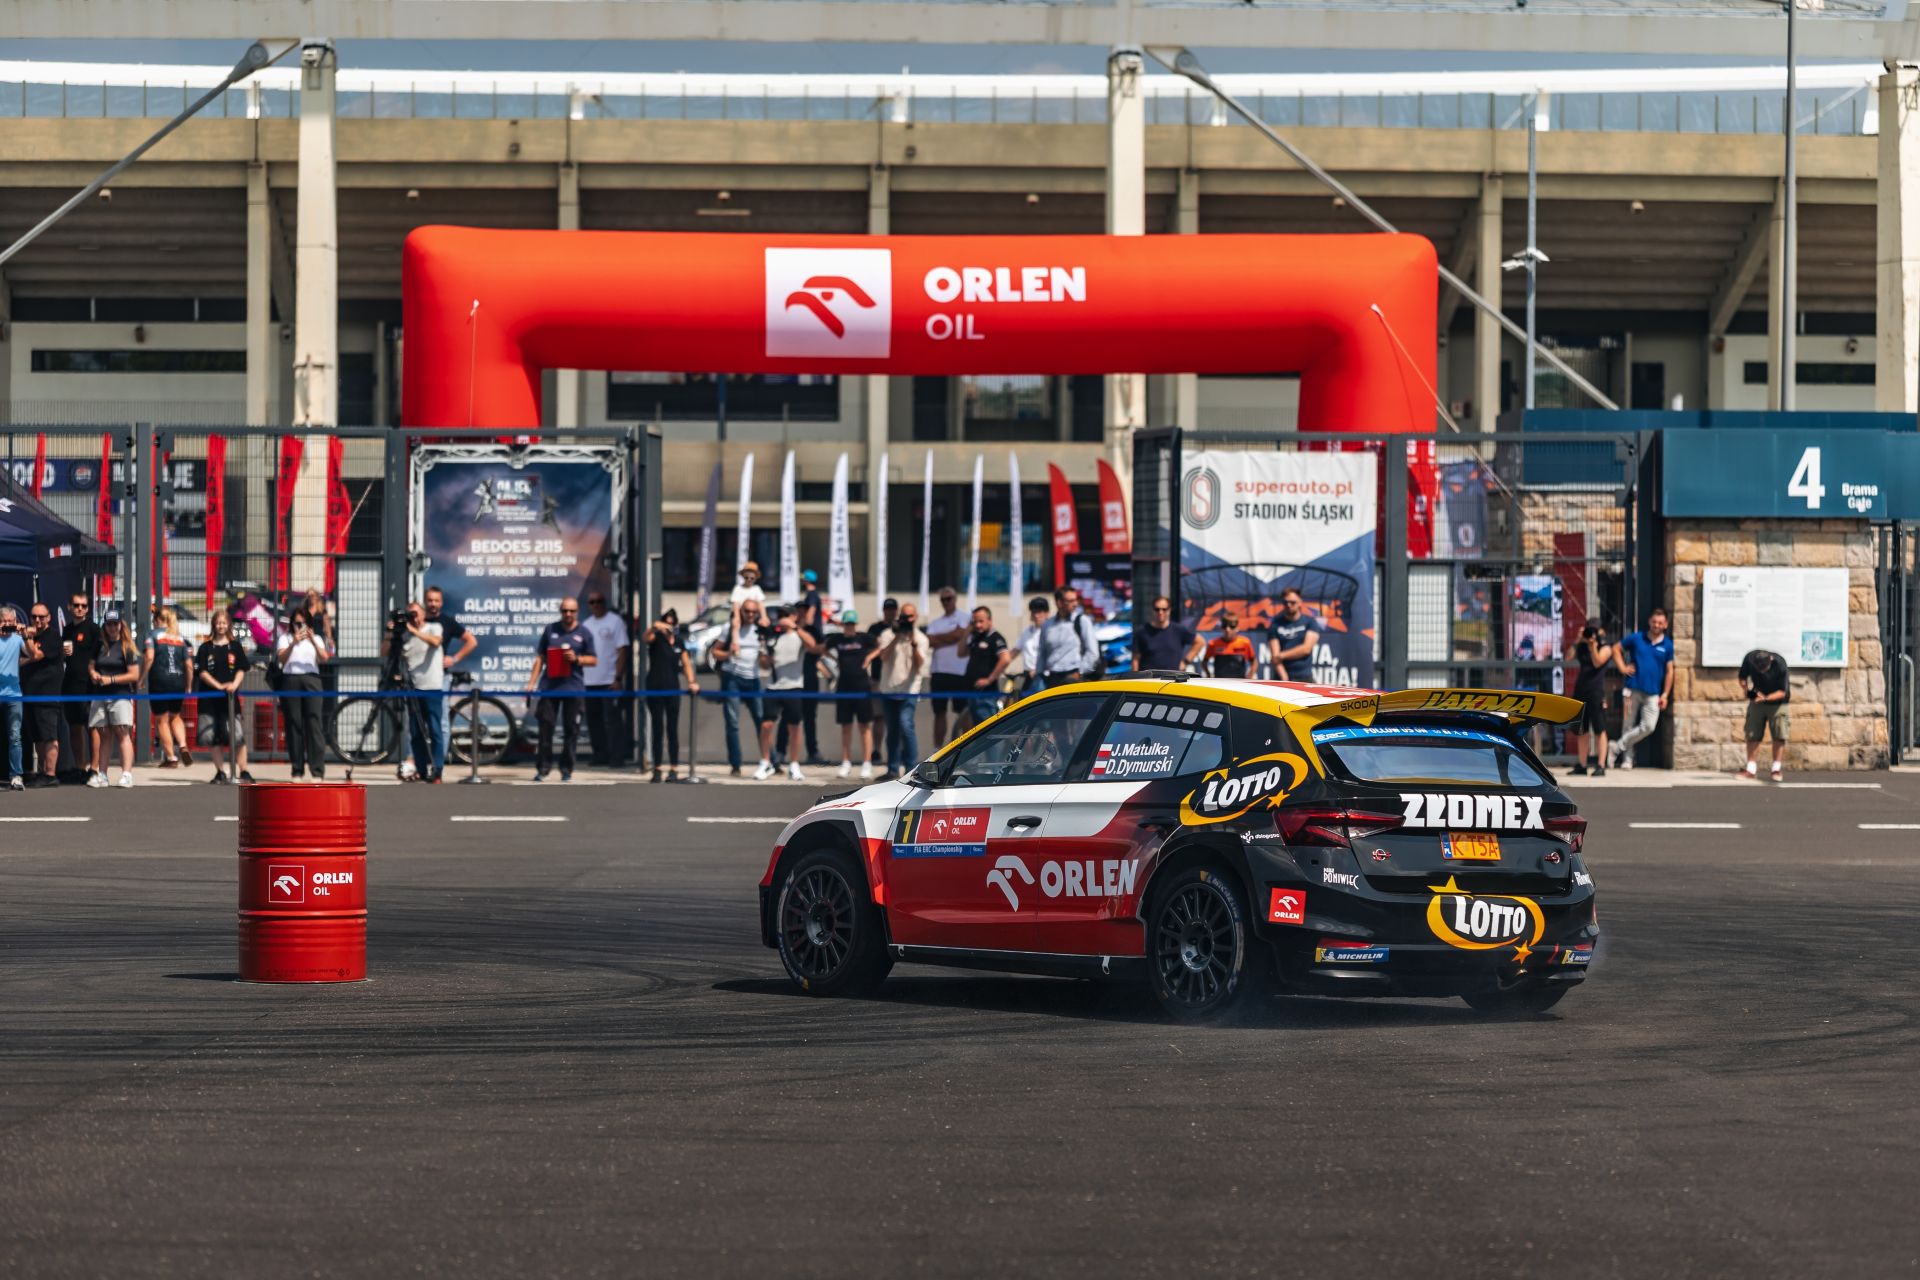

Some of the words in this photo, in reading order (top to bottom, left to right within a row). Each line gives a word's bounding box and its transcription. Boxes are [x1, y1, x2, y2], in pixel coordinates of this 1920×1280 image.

[923, 266, 1086, 303] ORLEN
[925, 313, 985, 340] OIL
[1788, 446, 1826, 509] 4
[1234, 481, 1353, 497] superauto.pl
[1841, 482, 1878, 497] Brama
[1234, 503, 1297, 519] STADION
[1301, 500, 1354, 525] ŚLĄSKI
[470, 540, 531, 554] BEDOES
[534, 540, 563, 554] 2115
[510, 555, 538, 566] LOUIS
[540, 555, 577, 566] VILLAIN
[464, 598, 505, 612] ALAN
[455, 613, 509, 624] DIMENSION
[495, 626, 532, 636] BLETKA
[481, 656, 499, 670] DJ
[502, 656, 535, 670] SNA
[483, 672, 507, 681] KIZO
[1420, 692, 1534, 714] LAKMA
[1110, 743, 1170, 757] J.Matulka
[1105, 756, 1173, 777] D.Dymurski
[1203, 766, 1281, 812] LOTTO
[902, 810, 914, 844] 1
[953, 816, 977, 826] ORLEN
[951, 827, 960, 835] OIL
[932, 846, 963, 854] Championship
[312, 872, 353, 884] ORLEN
[1040, 859, 1139, 897] ORLEN
[312, 886, 331, 896] OIL
[1273, 911, 1300, 920] ORLEN
[1454, 895, 1526, 938] LOTTO
[1336, 952, 1384, 960] MICHELIN
